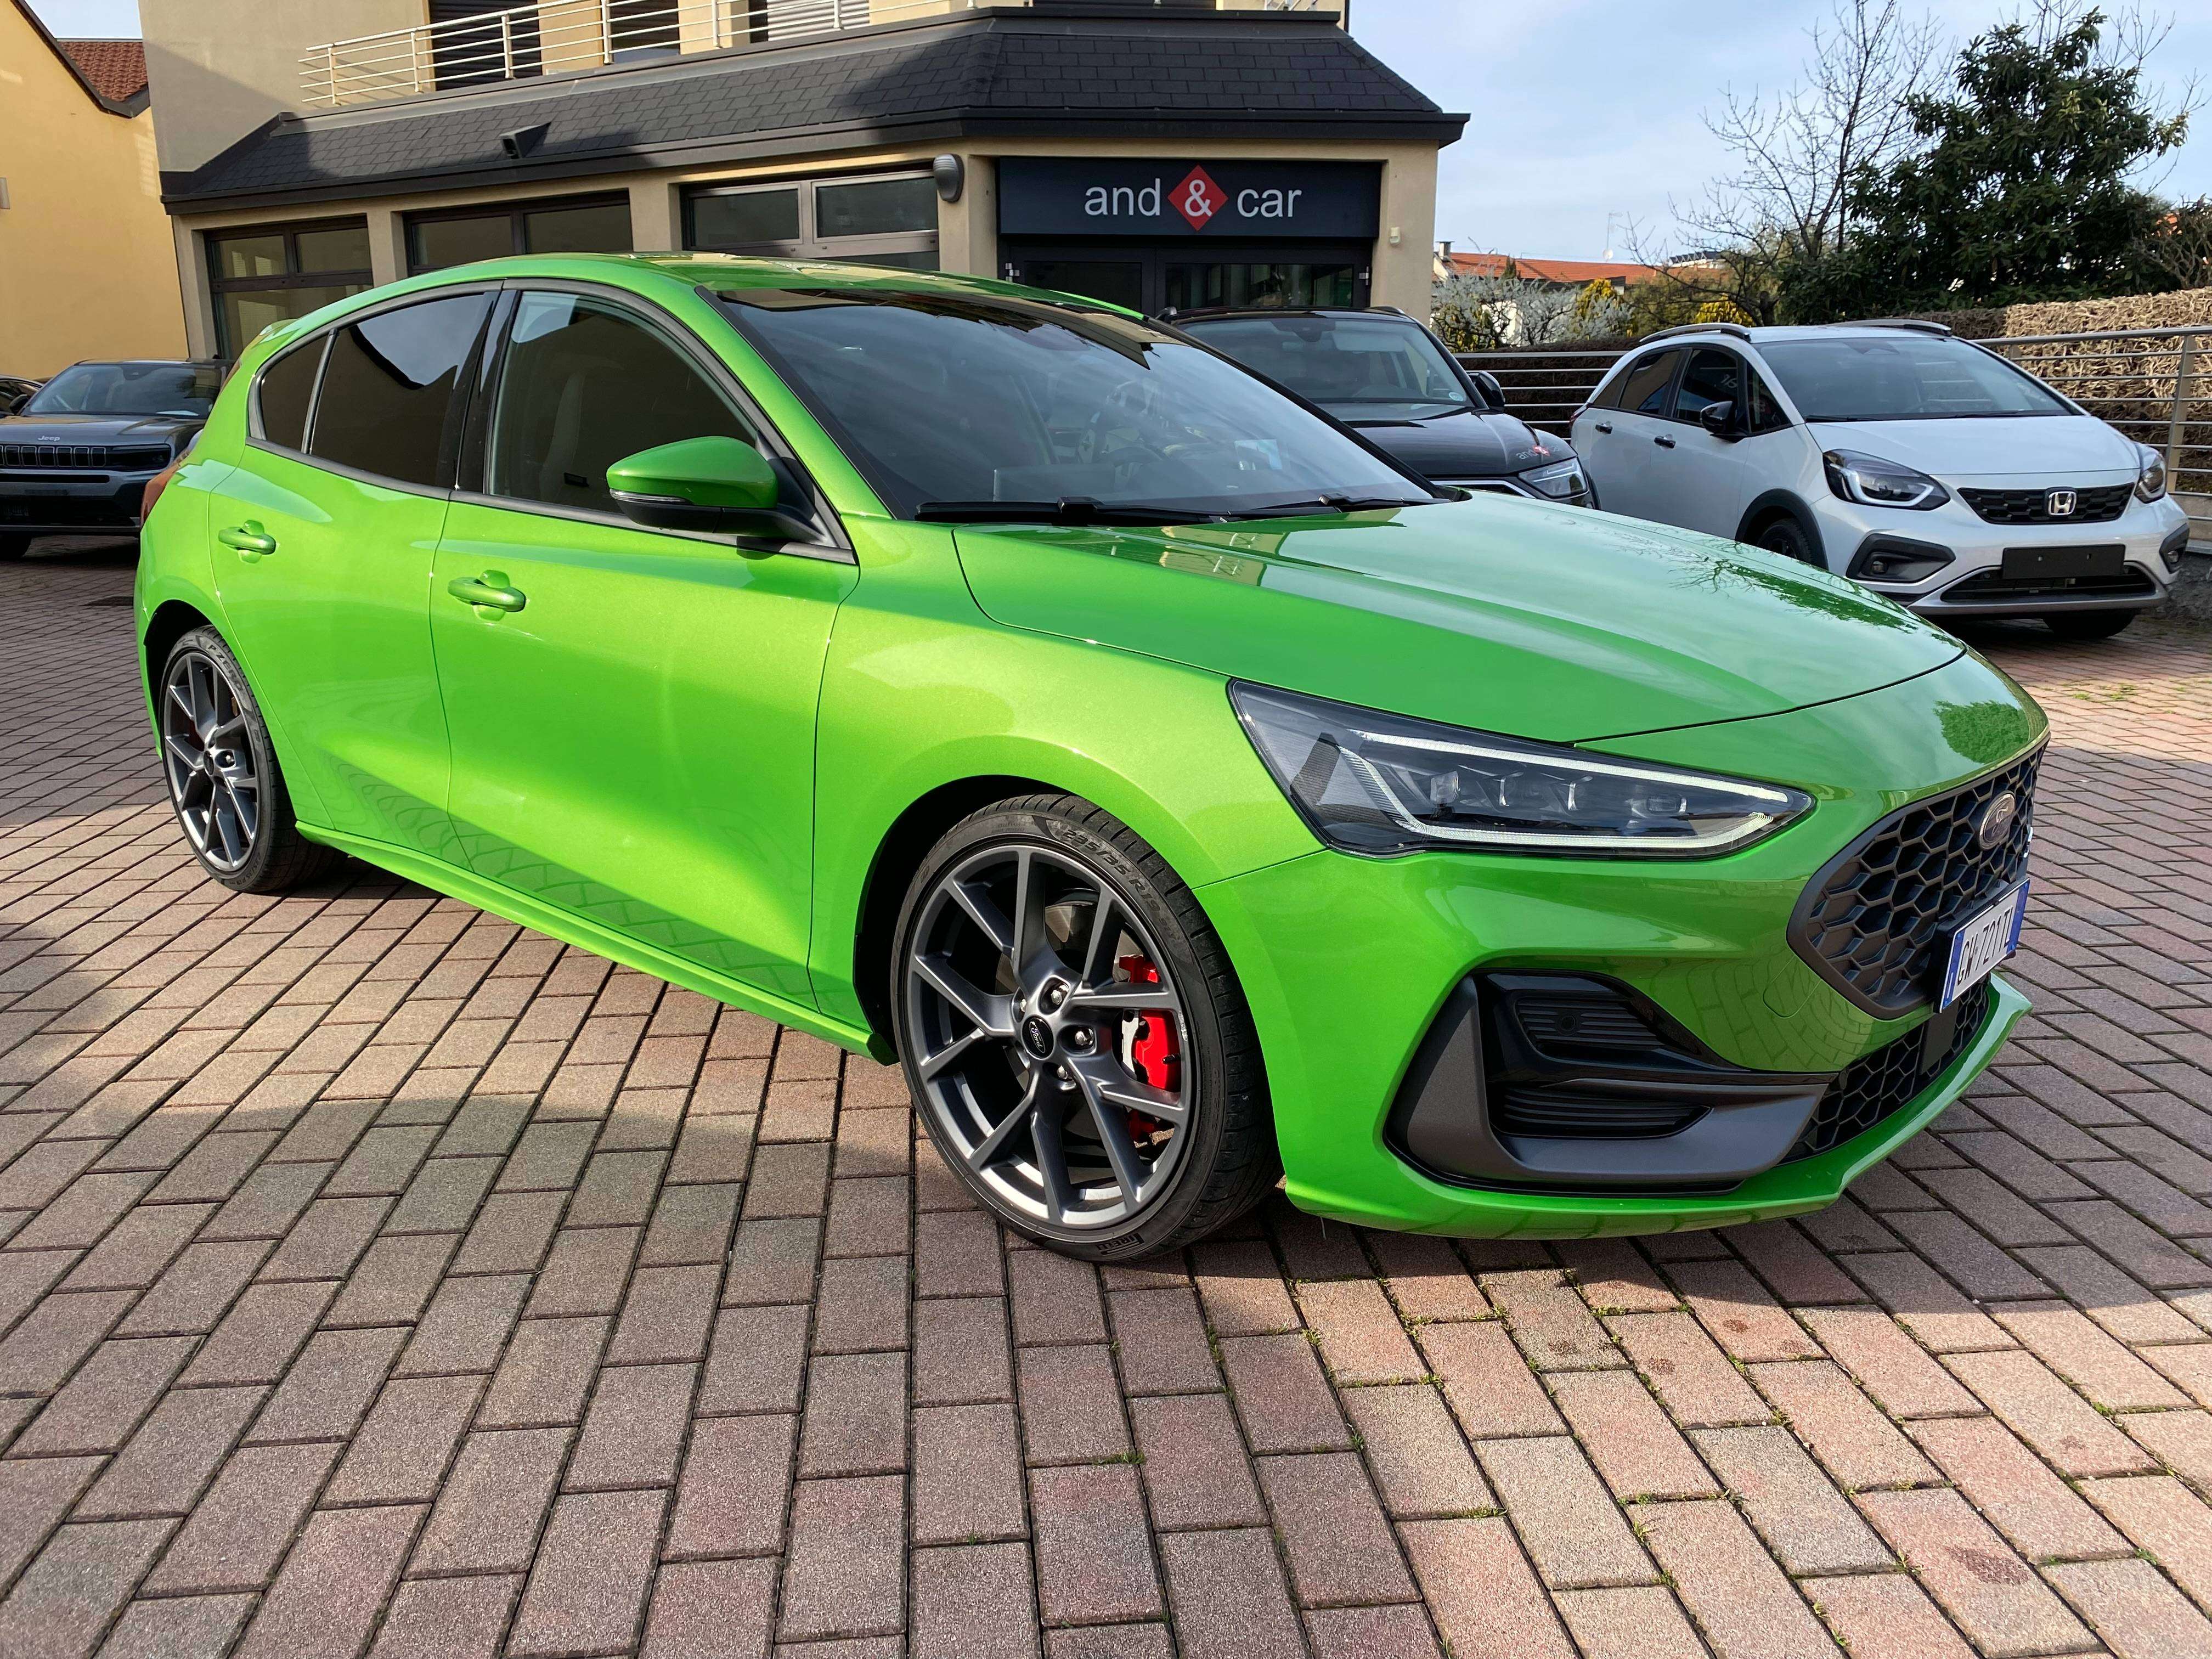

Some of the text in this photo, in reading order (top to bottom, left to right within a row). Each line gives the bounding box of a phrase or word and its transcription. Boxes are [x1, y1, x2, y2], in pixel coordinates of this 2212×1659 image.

[1084, 178, 1302, 218] and & car
[216, 652, 244, 691] ZERO
[1063, 829, 1131, 875] 235/35
[1128, 879, 1160, 912] R19
[1975, 906, 2013, 971] 721TL
[1031, 1027, 1043, 1048] Ford
[1097, 1233, 1145, 1255] PIRELLI
